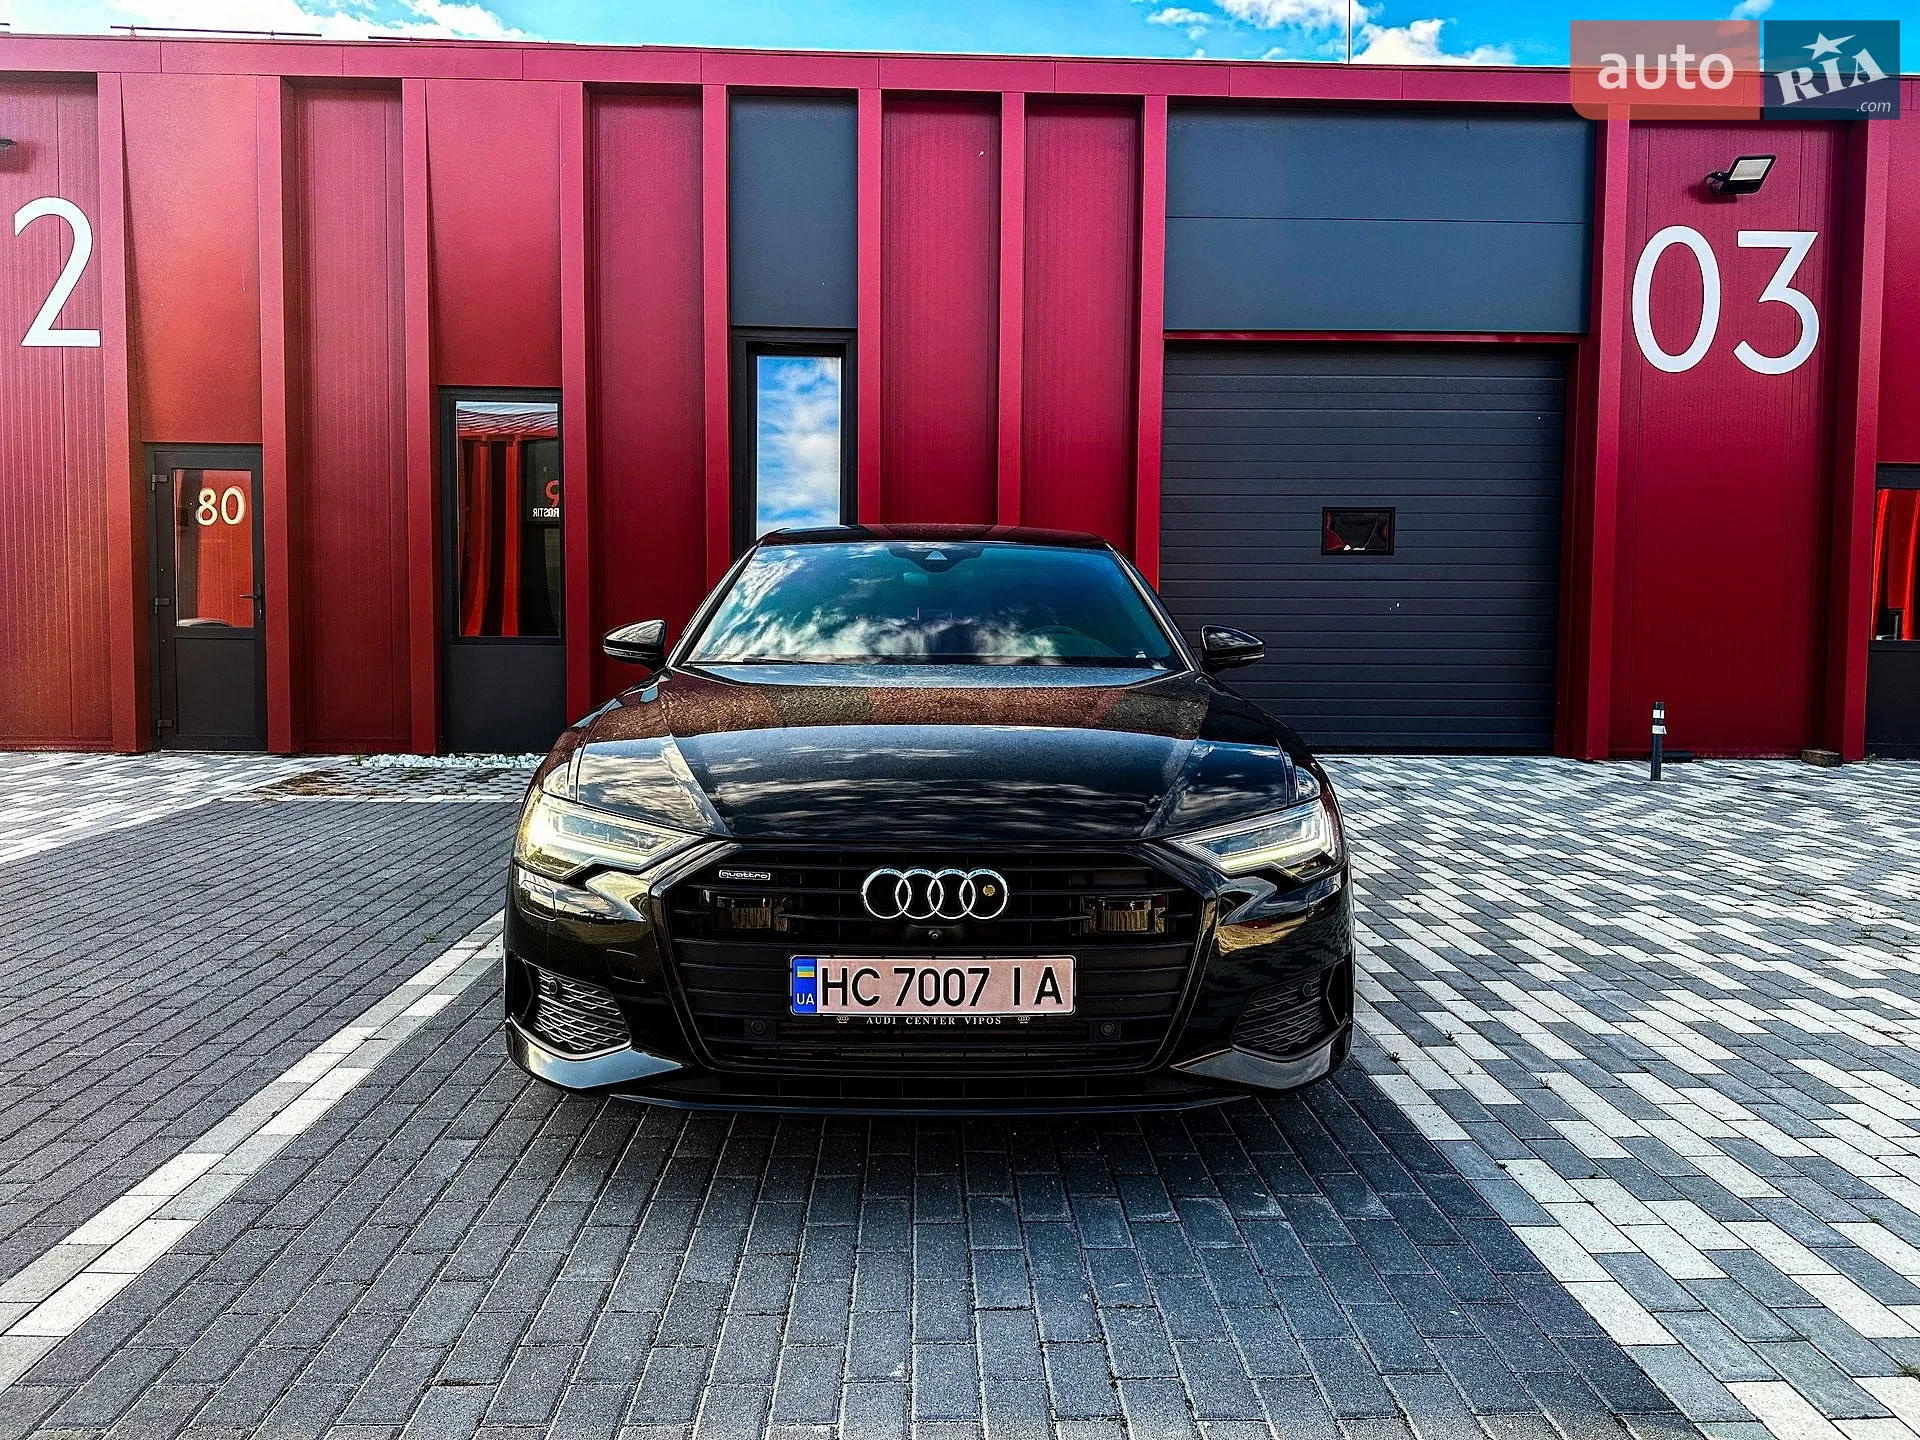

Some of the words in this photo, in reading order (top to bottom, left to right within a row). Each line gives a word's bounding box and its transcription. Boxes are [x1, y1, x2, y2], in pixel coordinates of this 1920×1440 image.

[14, 196, 102, 347] 2
[1632, 225, 1820, 375] 03
[196, 486, 246, 526] 80
[796, 993, 815, 1005] UA
[821, 966, 881, 1006] HC
[893, 966, 990, 1006] 7007
[866, 1016, 896, 1025] AUDI
[905, 1016, 956, 1025] CENTER
[964, 1016, 1001, 1025] VIPOS
